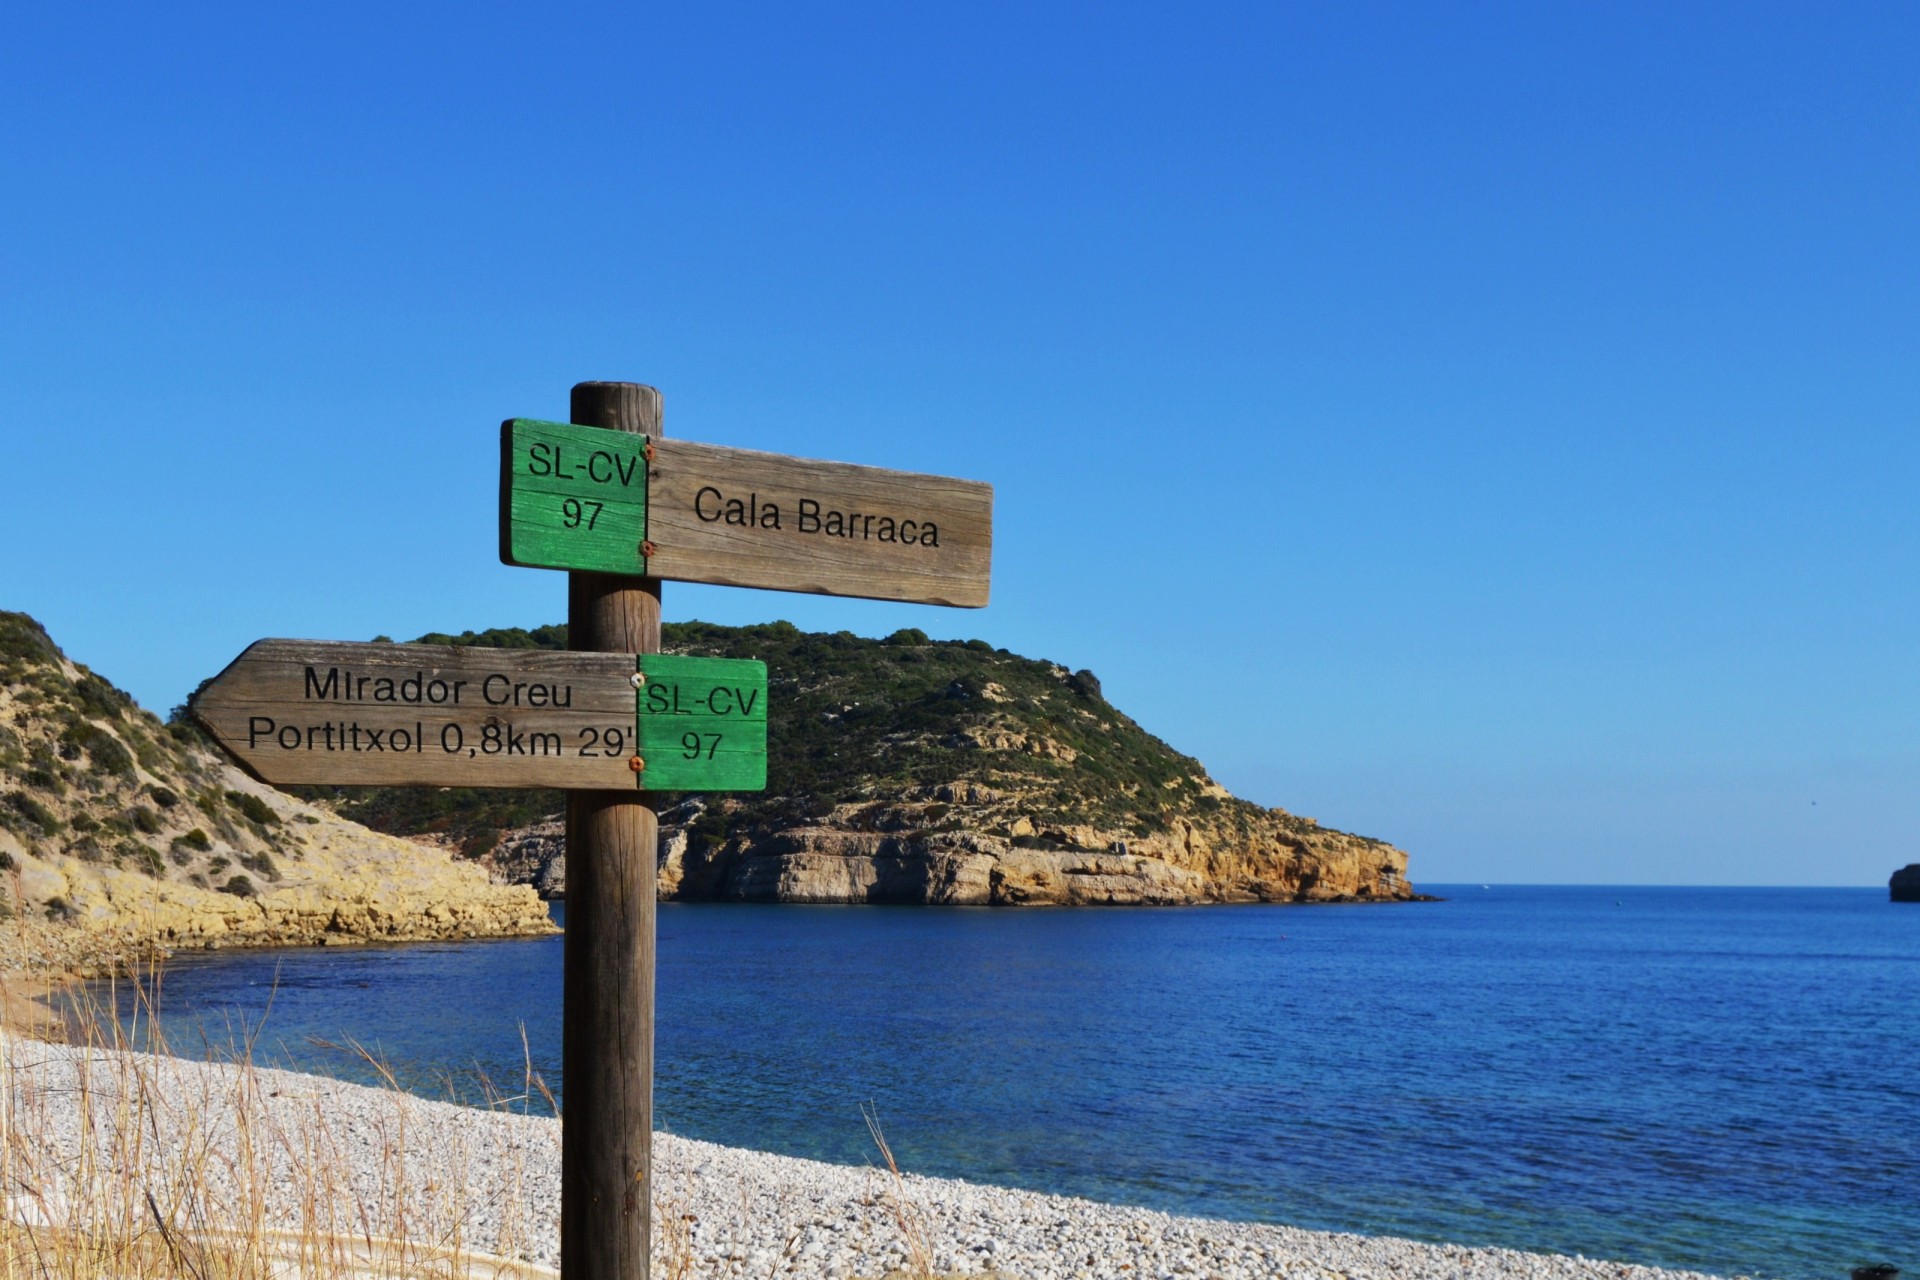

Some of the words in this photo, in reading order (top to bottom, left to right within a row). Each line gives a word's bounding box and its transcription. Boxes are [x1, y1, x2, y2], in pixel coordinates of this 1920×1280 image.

[528, 442, 638, 487] SL-CV
[561, 497, 604, 531] 97
[694, 486, 782, 530] Cala
[798, 498, 940, 548] Barraca
[482, 673, 572, 708] Creu
[646, 683, 758, 717] SL-CV
[249, 716, 422, 754] Portitxol
[441, 723, 562, 759] 0,8km
[578, 727, 632, 757] 29'
[682, 731, 723, 761] 97
